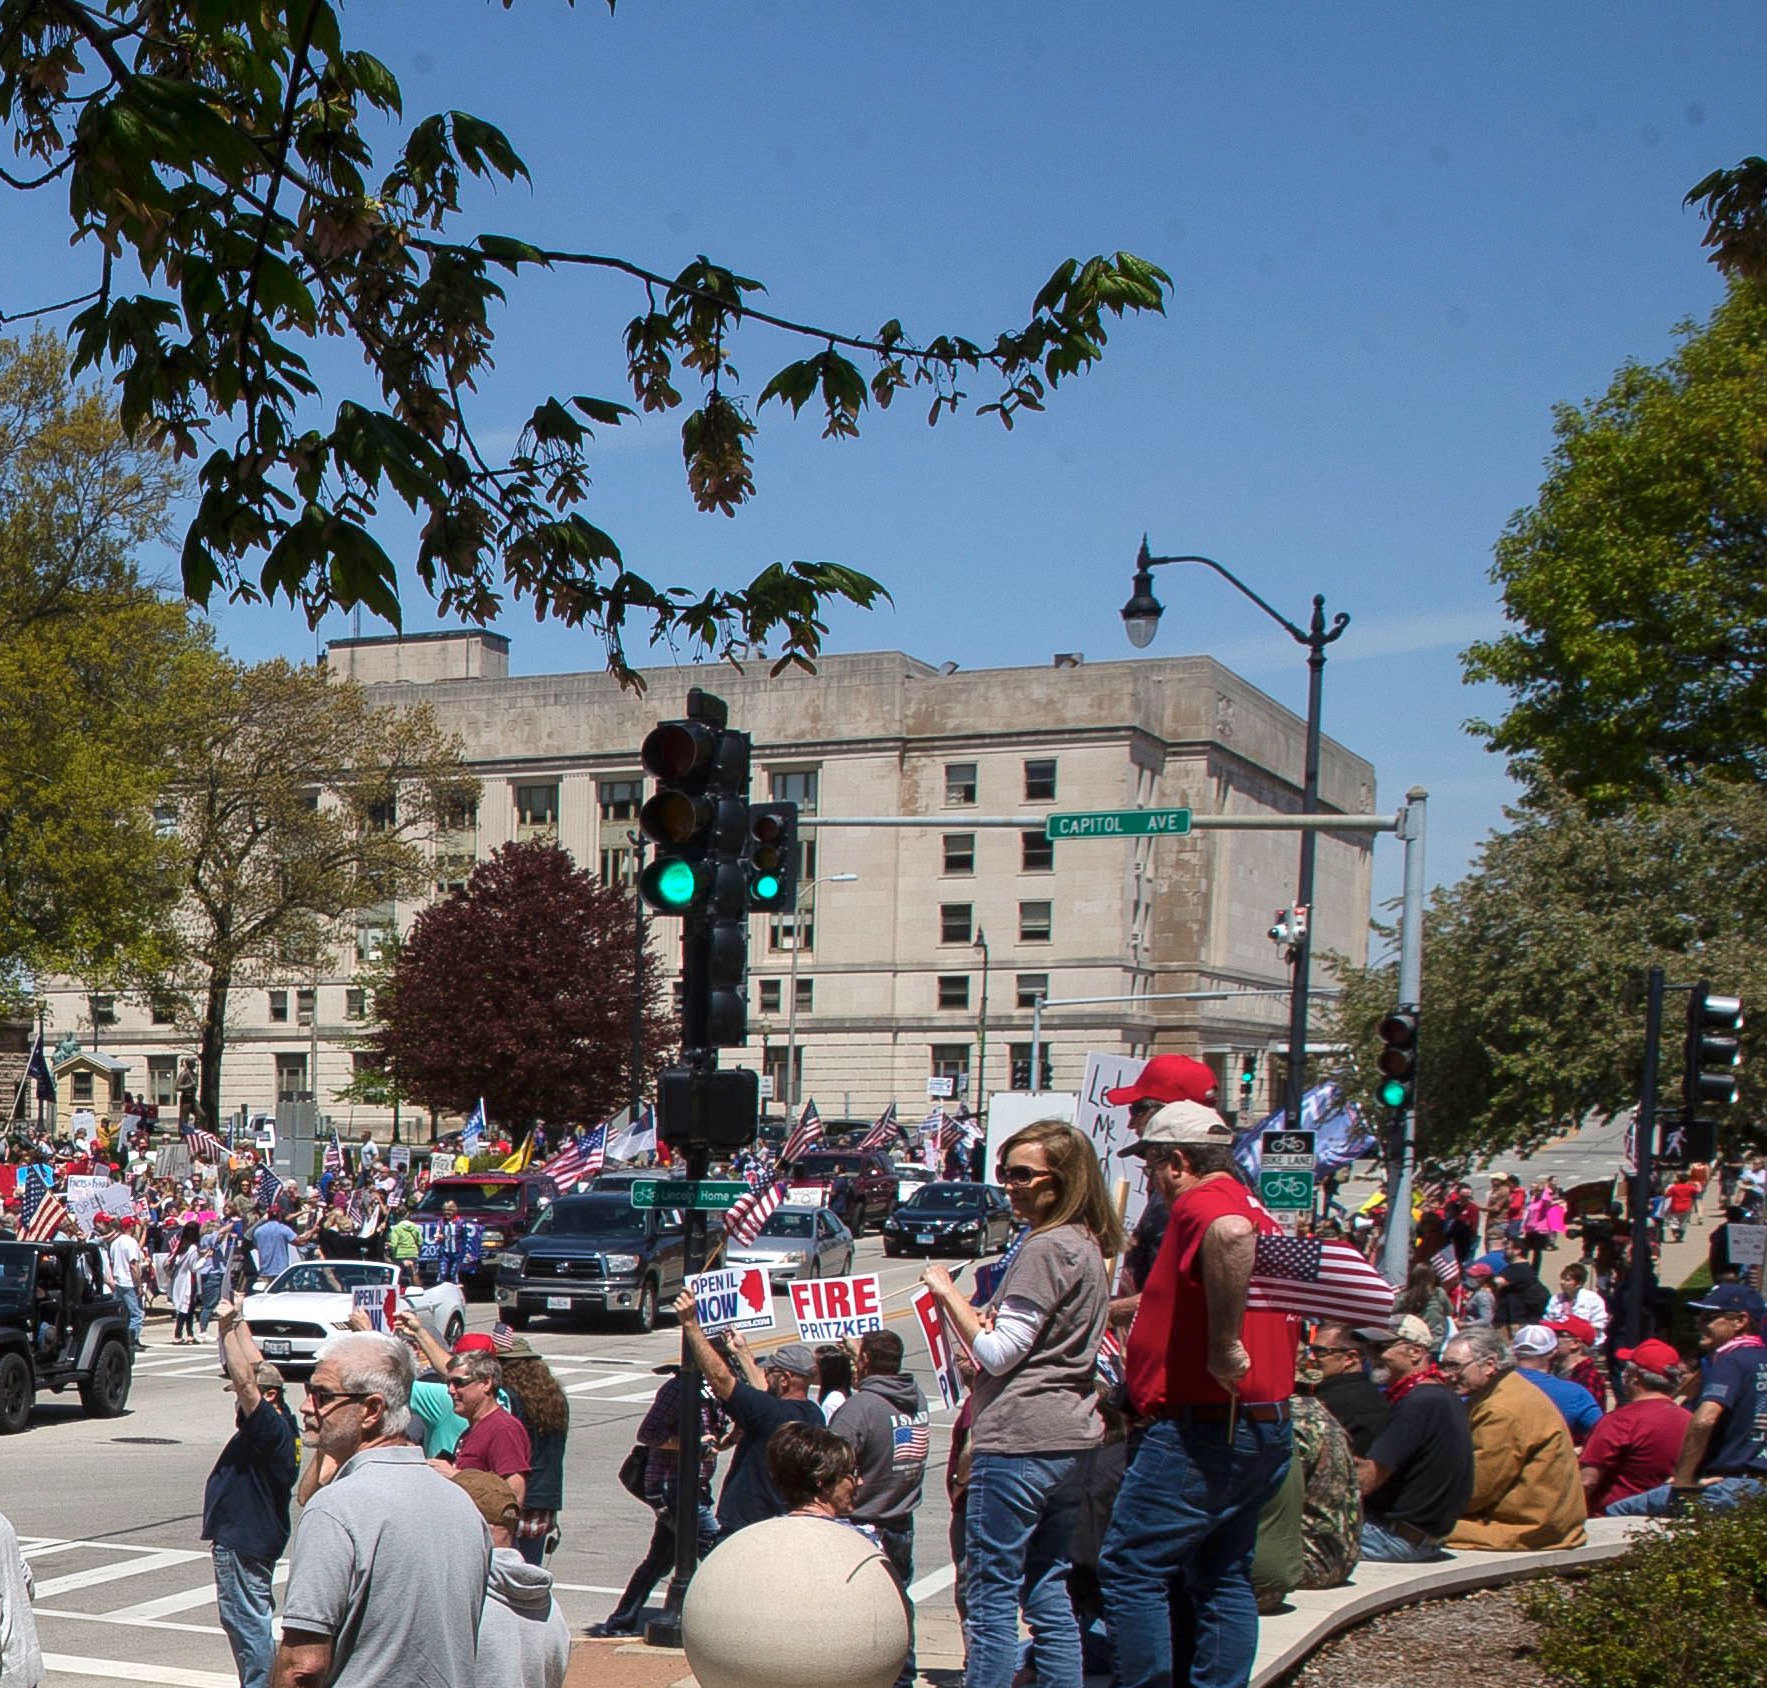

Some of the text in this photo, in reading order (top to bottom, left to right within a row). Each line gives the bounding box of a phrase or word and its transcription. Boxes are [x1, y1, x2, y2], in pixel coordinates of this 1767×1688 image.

[1059, 813, 1179, 834] CAPITOL AVE
[1262, 1155, 1313, 1166] BIKE LANE
[660, 1190, 730, 1202] Lincoln Home
[692, 1271, 738, 1297] OPEN IL
[353, 1288, 383, 1306] OPEN IL
[695, 1291, 739, 1324] NOW
[790, 1277, 879, 1320] FIRE
[800, 1316, 880, 1341] PRITZKER
